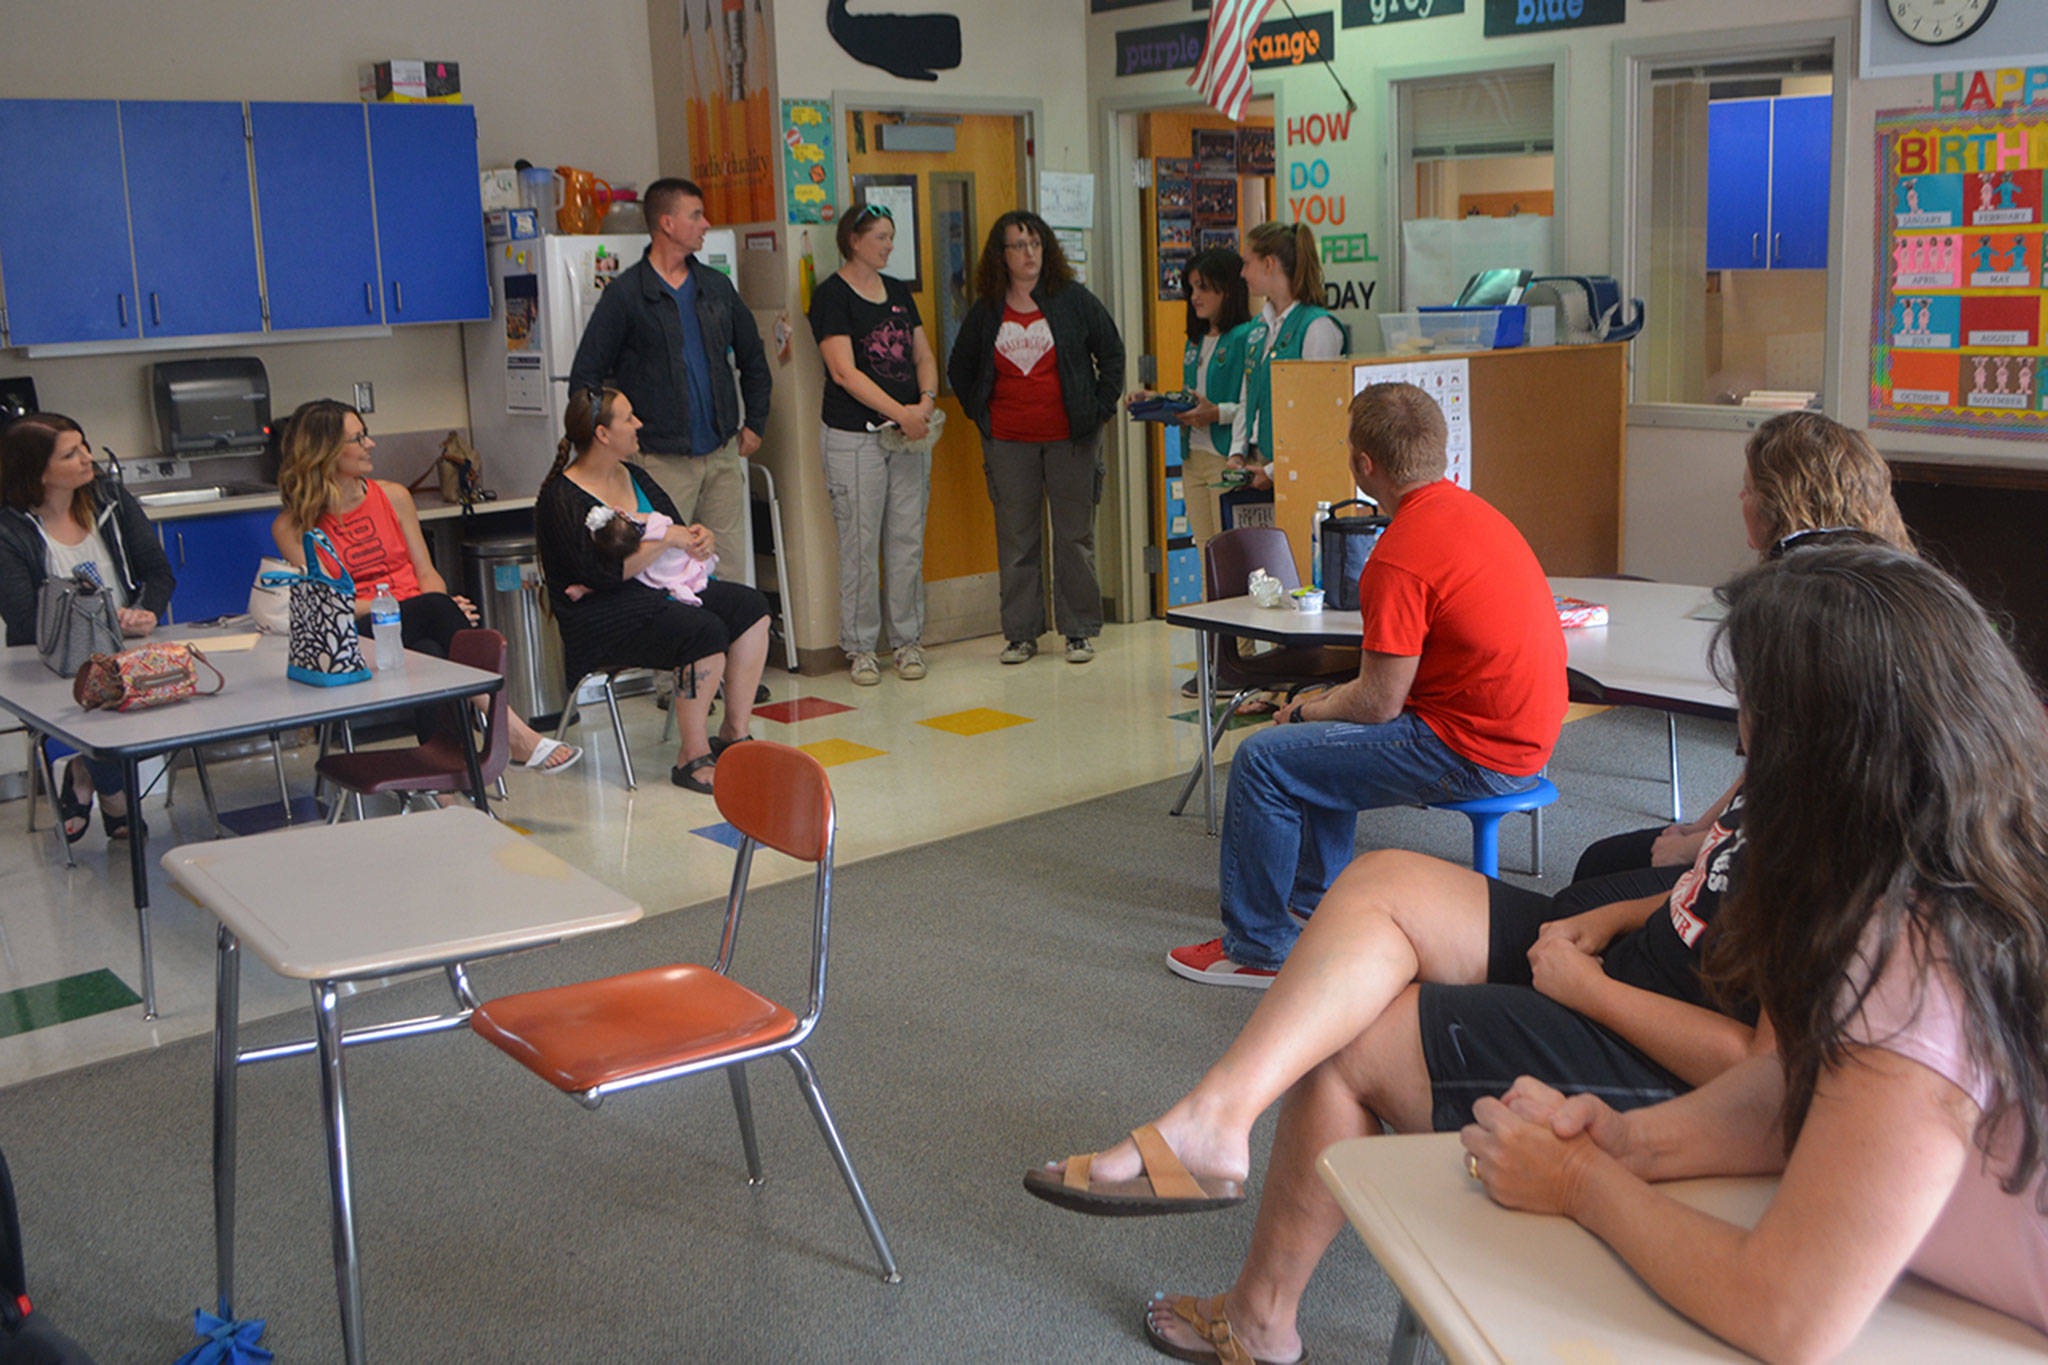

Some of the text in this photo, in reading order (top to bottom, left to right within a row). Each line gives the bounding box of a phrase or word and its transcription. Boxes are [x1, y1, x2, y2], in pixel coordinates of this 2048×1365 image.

[1124, 32, 1200, 74] purple
[1247, 29, 1321, 65] range
[1933, 66, 2048, 111] HAPP
[1287, 110, 1352, 147] HOW
[1291, 158, 1330, 190] DO
[1289, 194, 1346, 226] YOU
[1321, 233, 1379, 264] FEEL
[1325, 281, 1376, 311] DAY
